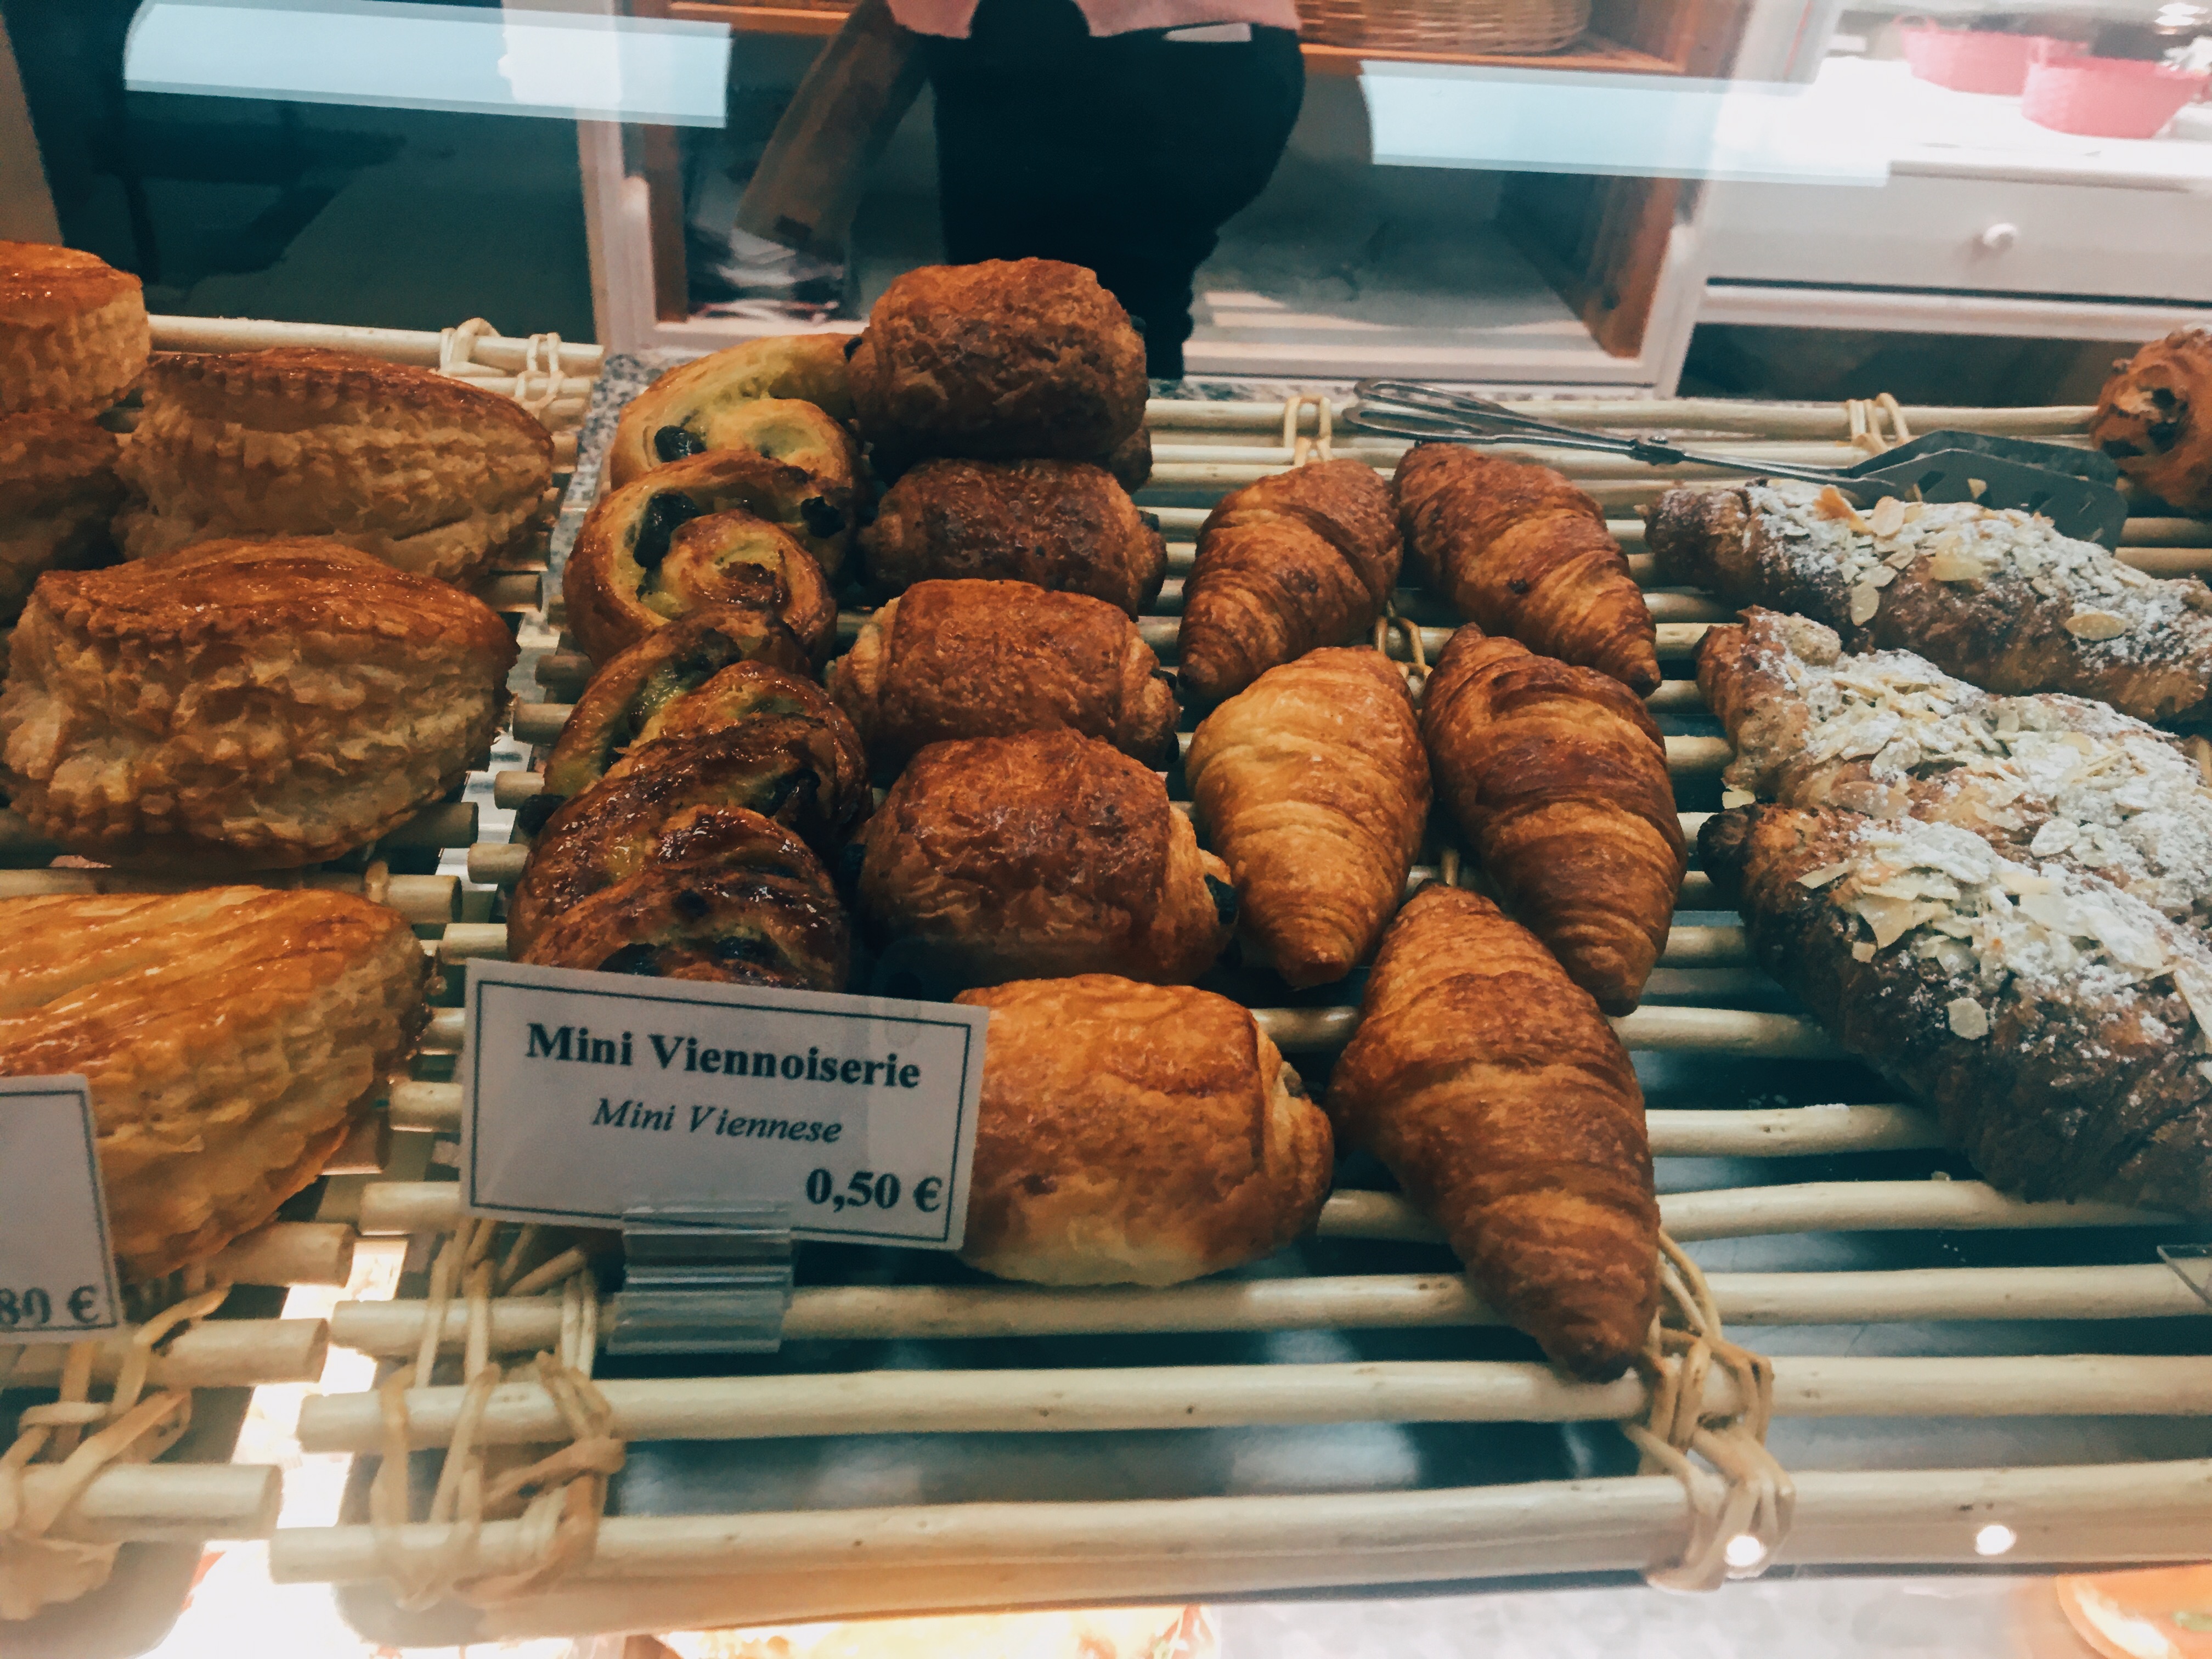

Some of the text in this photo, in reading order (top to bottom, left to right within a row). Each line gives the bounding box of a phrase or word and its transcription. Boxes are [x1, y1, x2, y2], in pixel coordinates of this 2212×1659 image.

[526, 1023, 922, 1089] Mini Viennoiserie
[591, 1098, 843, 1144] Mini Viennese
[805, 1167, 943, 1214] 0,50 €
[67, 1285, 100, 1323] €
